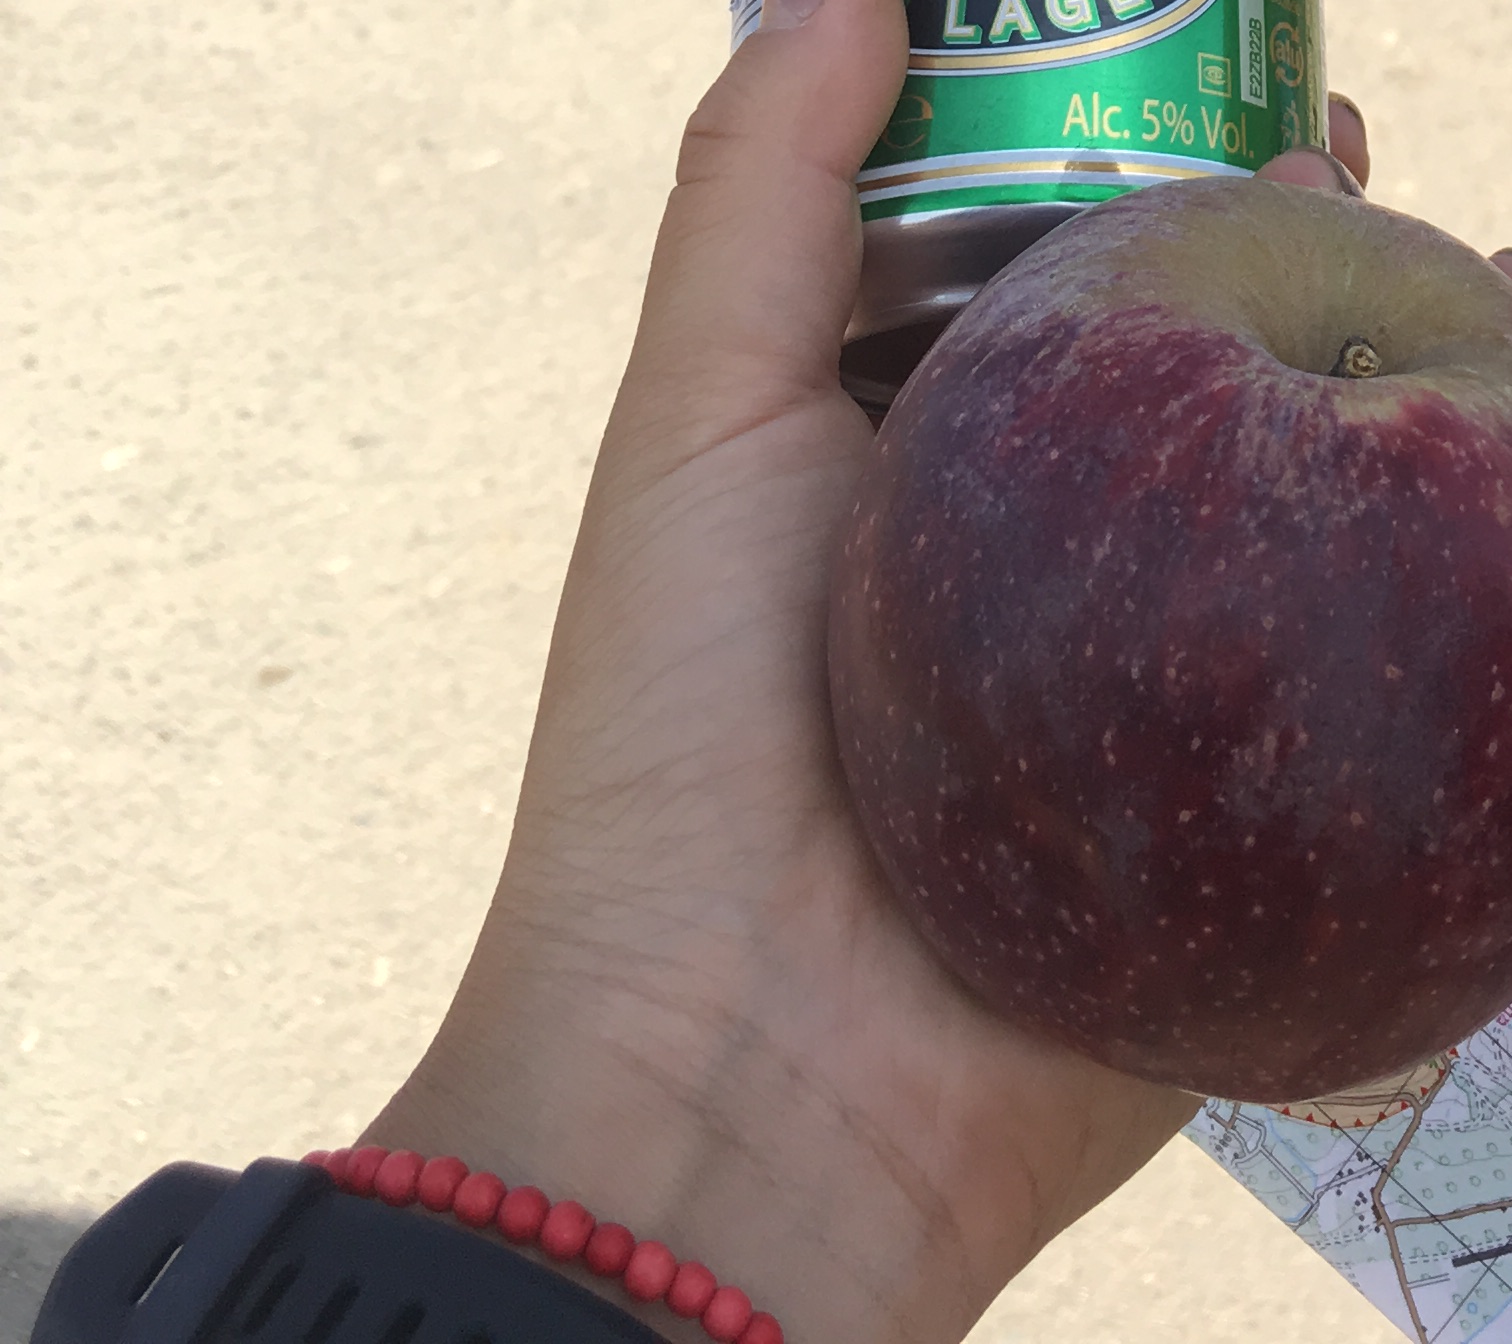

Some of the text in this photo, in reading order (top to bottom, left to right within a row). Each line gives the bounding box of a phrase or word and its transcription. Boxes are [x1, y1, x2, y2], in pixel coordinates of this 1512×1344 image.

[1061, 91, 1255, 159] Alc. 5% Vol.
